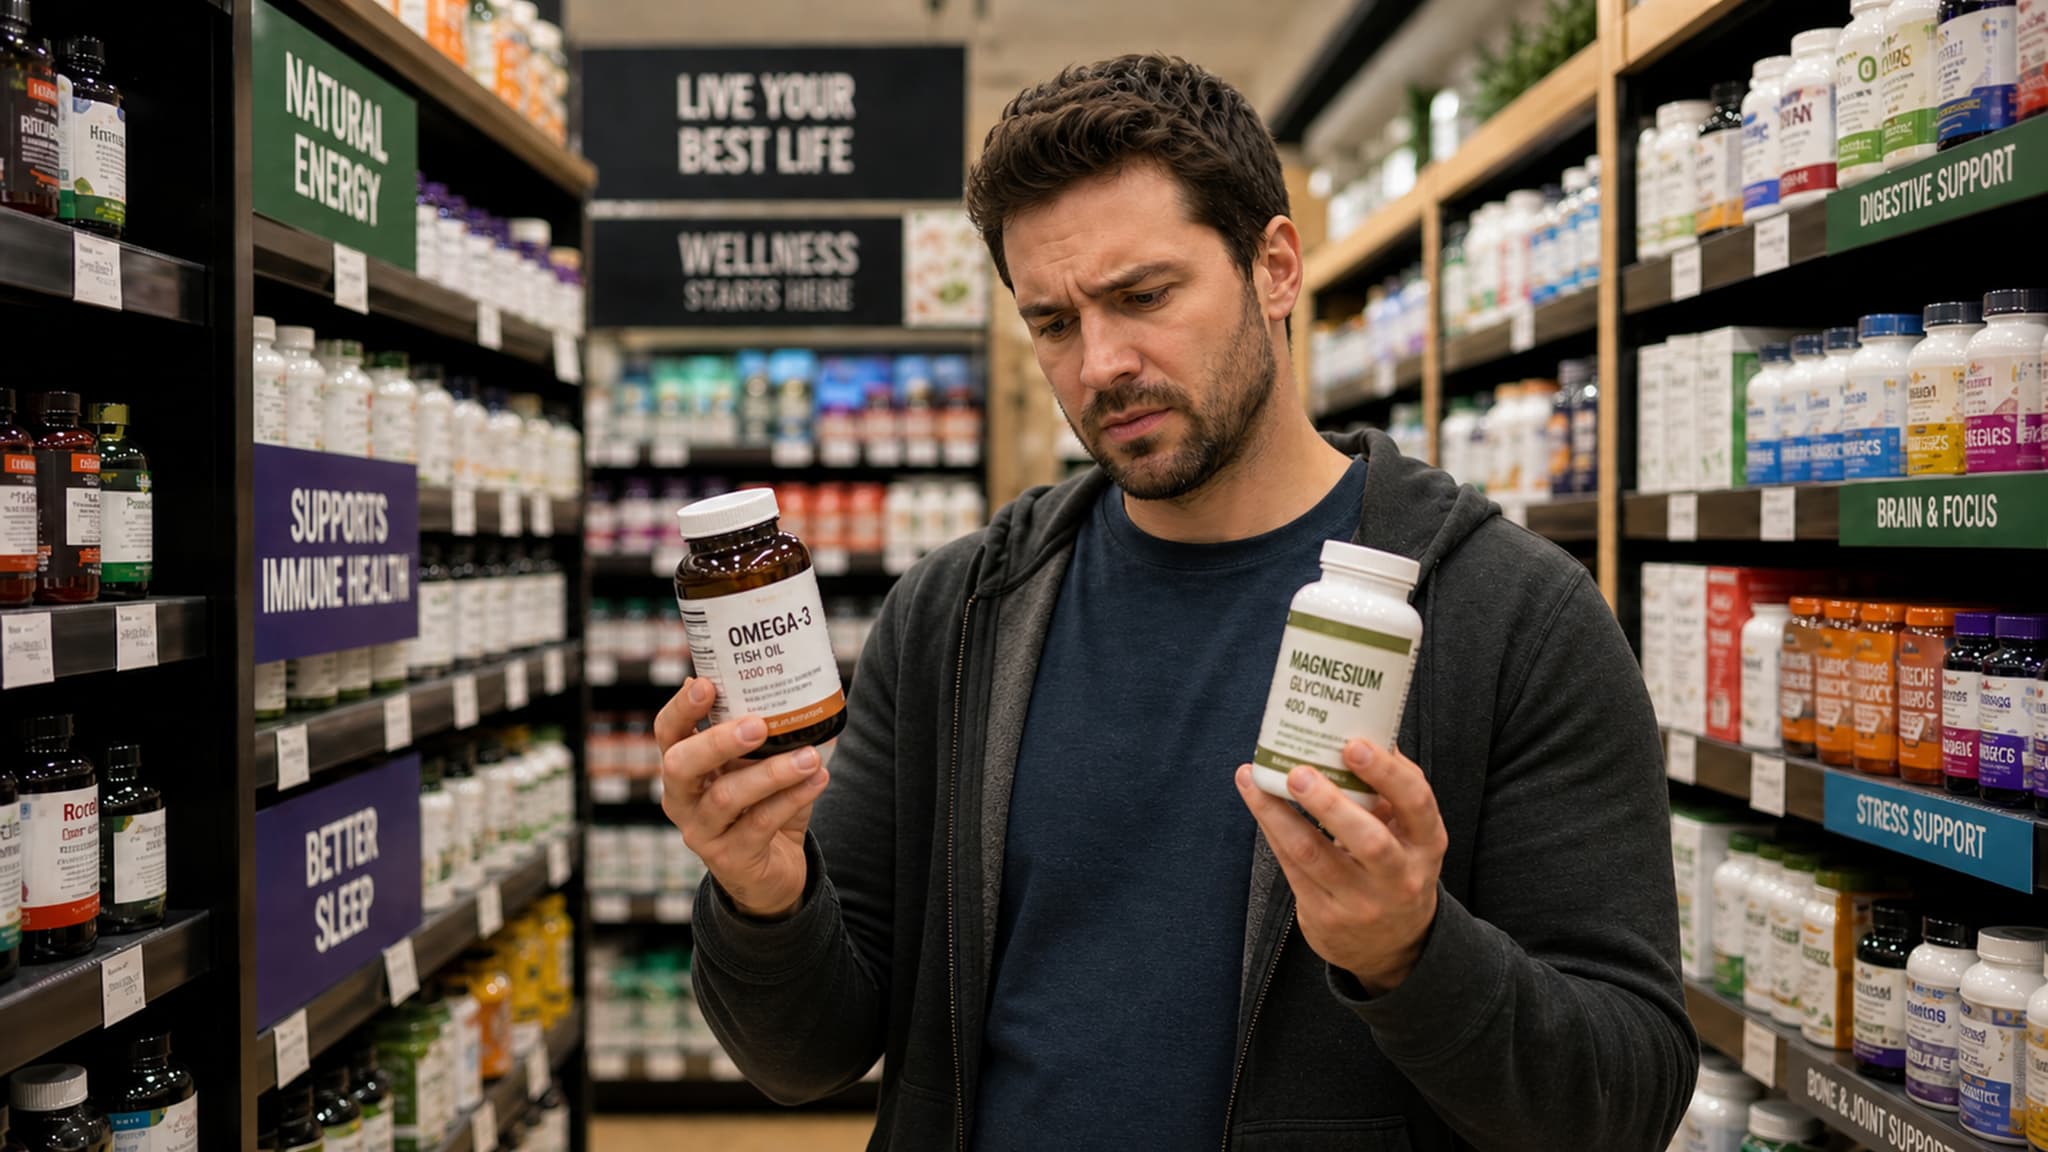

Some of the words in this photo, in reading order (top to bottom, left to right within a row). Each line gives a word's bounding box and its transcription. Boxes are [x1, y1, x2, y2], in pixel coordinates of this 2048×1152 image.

[285, 51, 388, 165] NATURAL
[677, 73, 755, 121] LIVE
[760, 72, 856, 120] YOUR
[678, 126, 771, 175] BEST
[776, 126, 855, 174] LIFE
[294, 132, 381, 226] ENERGY
[1859, 172, 1933, 227] DIGESTIVE
[1937, 143, 2016, 202] SUPPORT
[678, 231, 860, 277] WELLNESS
[290, 487, 389, 544] SUPPORTS
[1877, 496, 1922, 529] BRAIN
[1926, 495, 1939, 528] &
[1943, 493, 1998, 528] FOCUS
[262, 556, 343, 614] IMMUNE
[346, 553, 410, 607] HEALTH
[728, 606, 811, 647] OMEGA-3
[734, 649, 761, 664] FISH
[764, 643, 784, 658] OIL
[738, 666, 764, 680] 1200
[766, 663, 783, 675] mg
[1289, 649, 1383, 691] MAGNESIUM
[1285, 698, 1305, 714] 400
[1307, 706, 1328, 724] mg
[1290, 675, 1363, 708] GLYCINATE
[305, 807, 379, 888] BETTER
[1857, 794, 1909, 836] STRESS
[1913, 809, 1986, 860] SUPPORT
[314, 874, 375, 953] SLEEP
[1807, 1067, 1837, 1110] BONE
[1838, 1087, 1849, 1117] &
[1850, 1094, 1887, 1138] JOINT
[1888, 1114, 1955, 1152] SUPPO
